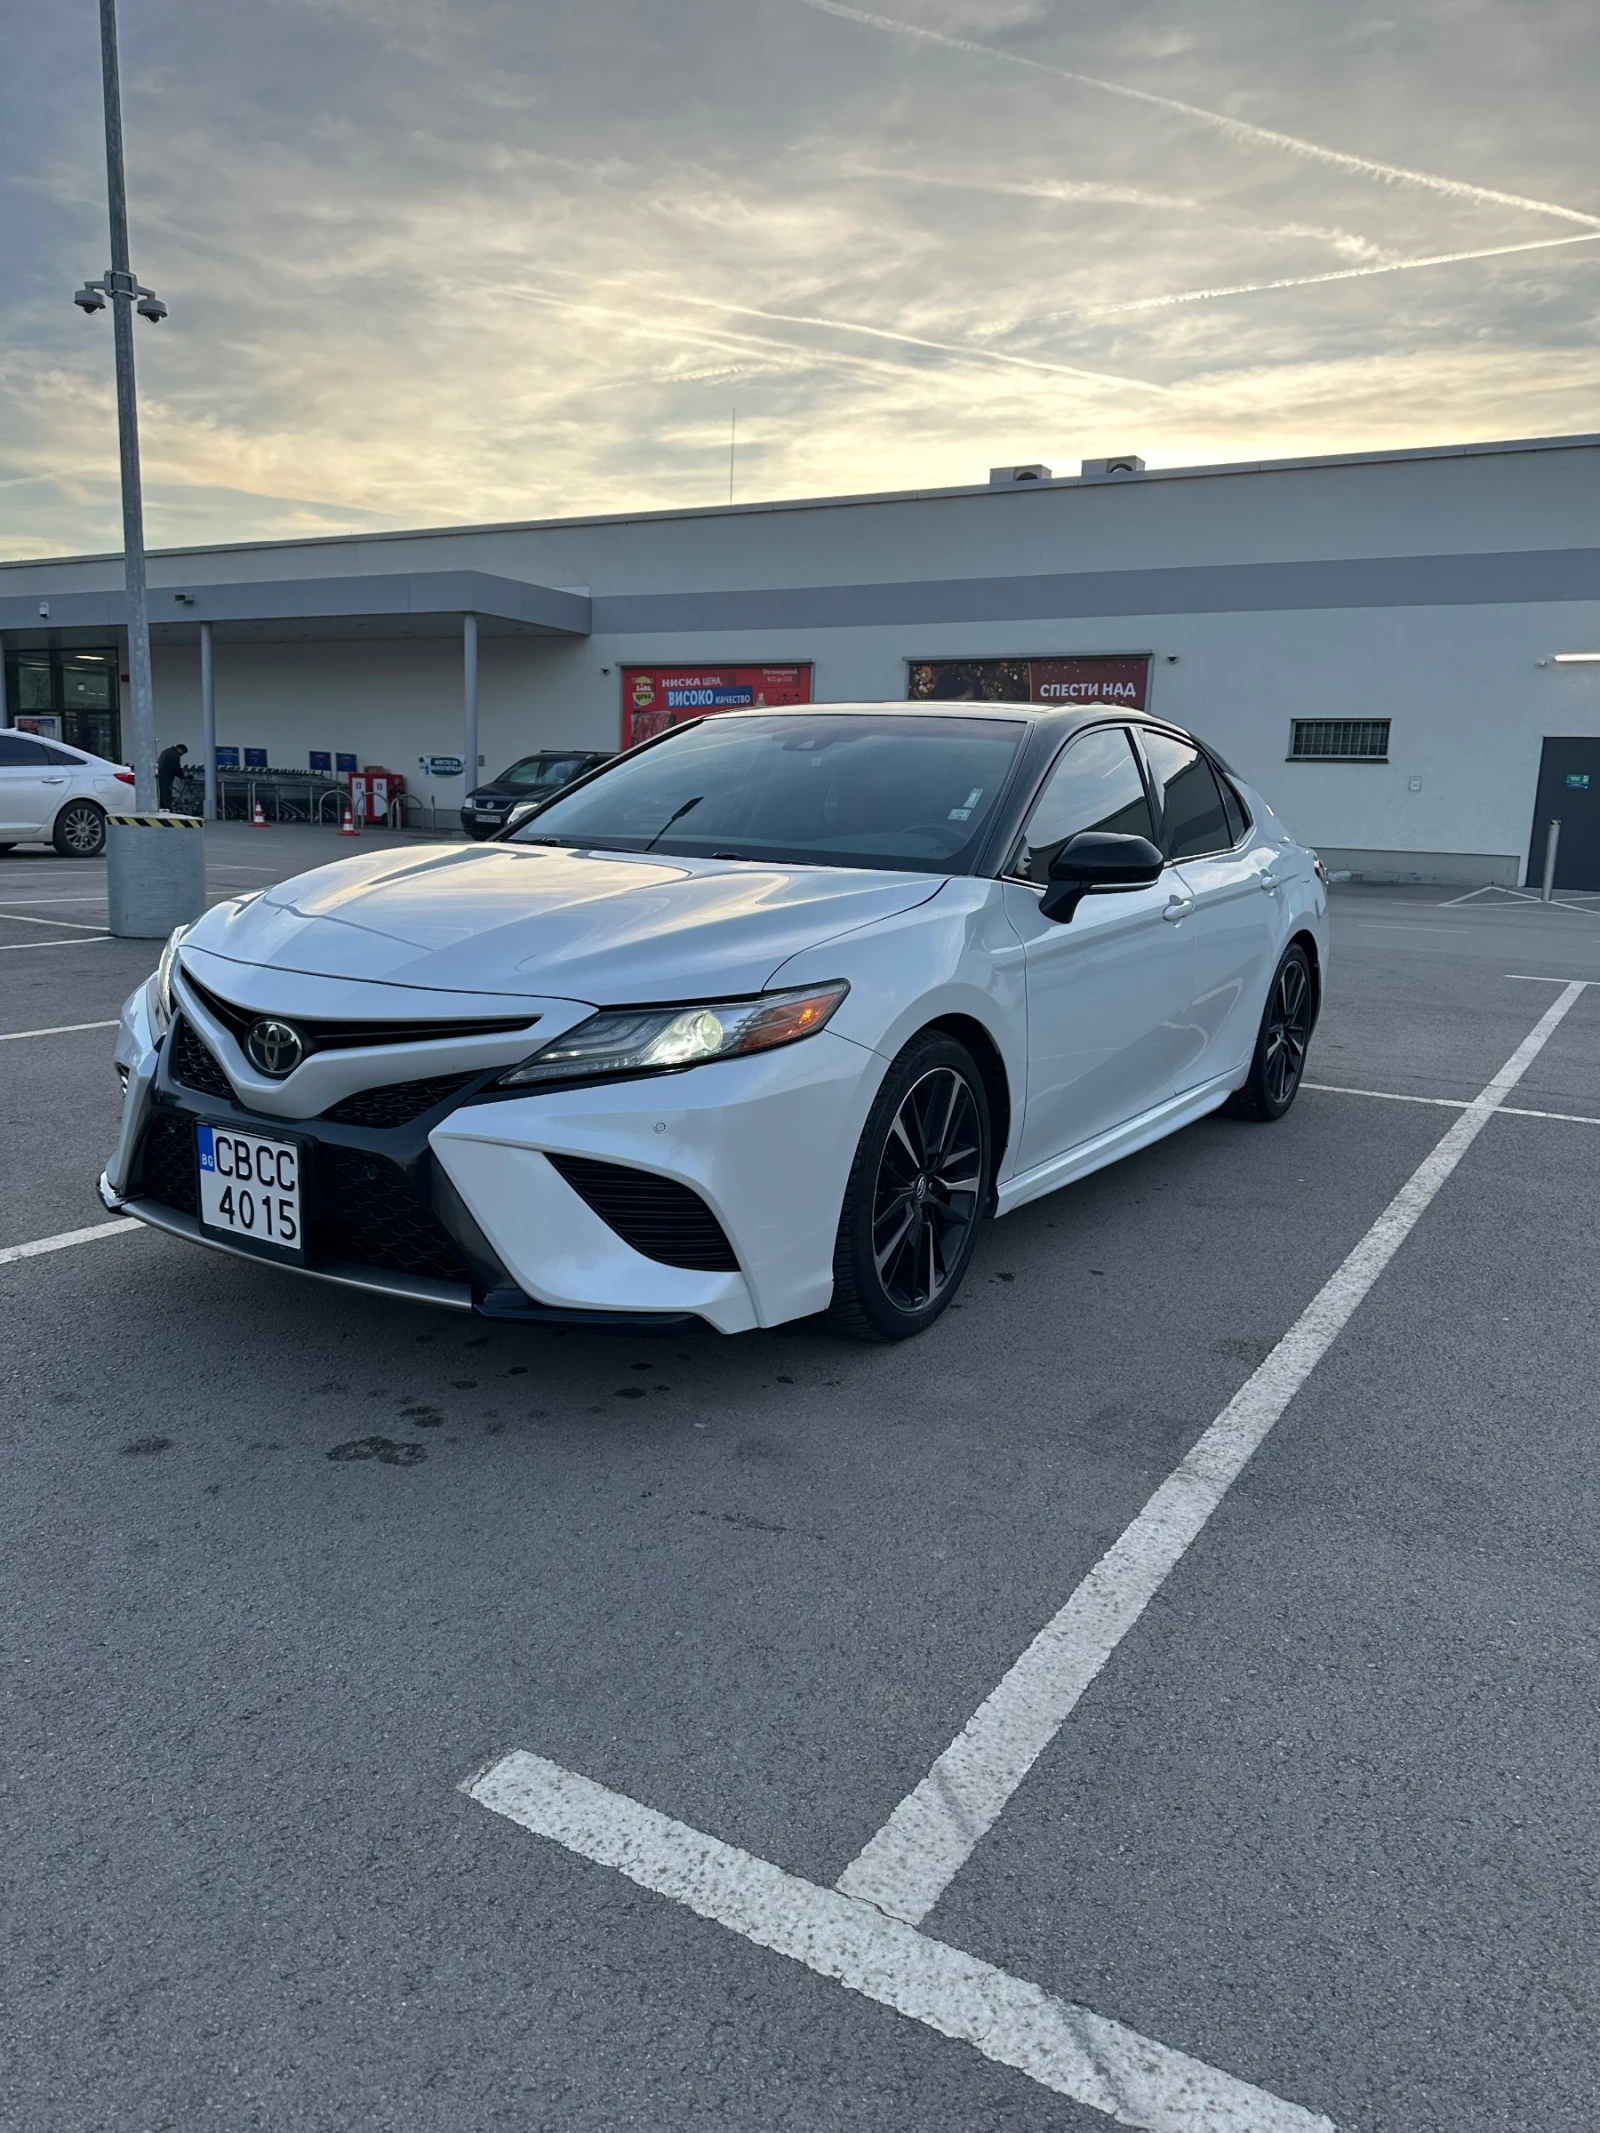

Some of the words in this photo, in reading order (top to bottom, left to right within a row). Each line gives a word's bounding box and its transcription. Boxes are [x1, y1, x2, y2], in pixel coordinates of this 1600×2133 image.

[662, 678, 700, 687] НИСКА
[1040, 683, 1098, 697] СПЕСТИ
[1102, 682, 1136, 697] НАД
[668, 689, 713, 706] ВИСОКО
[715, 694, 750, 705] КАЧЕСТВО
[202, 1153, 214, 1167] BG
[215, 1136, 295, 1192] CBCC
[219, 1185, 297, 1240] 4015
